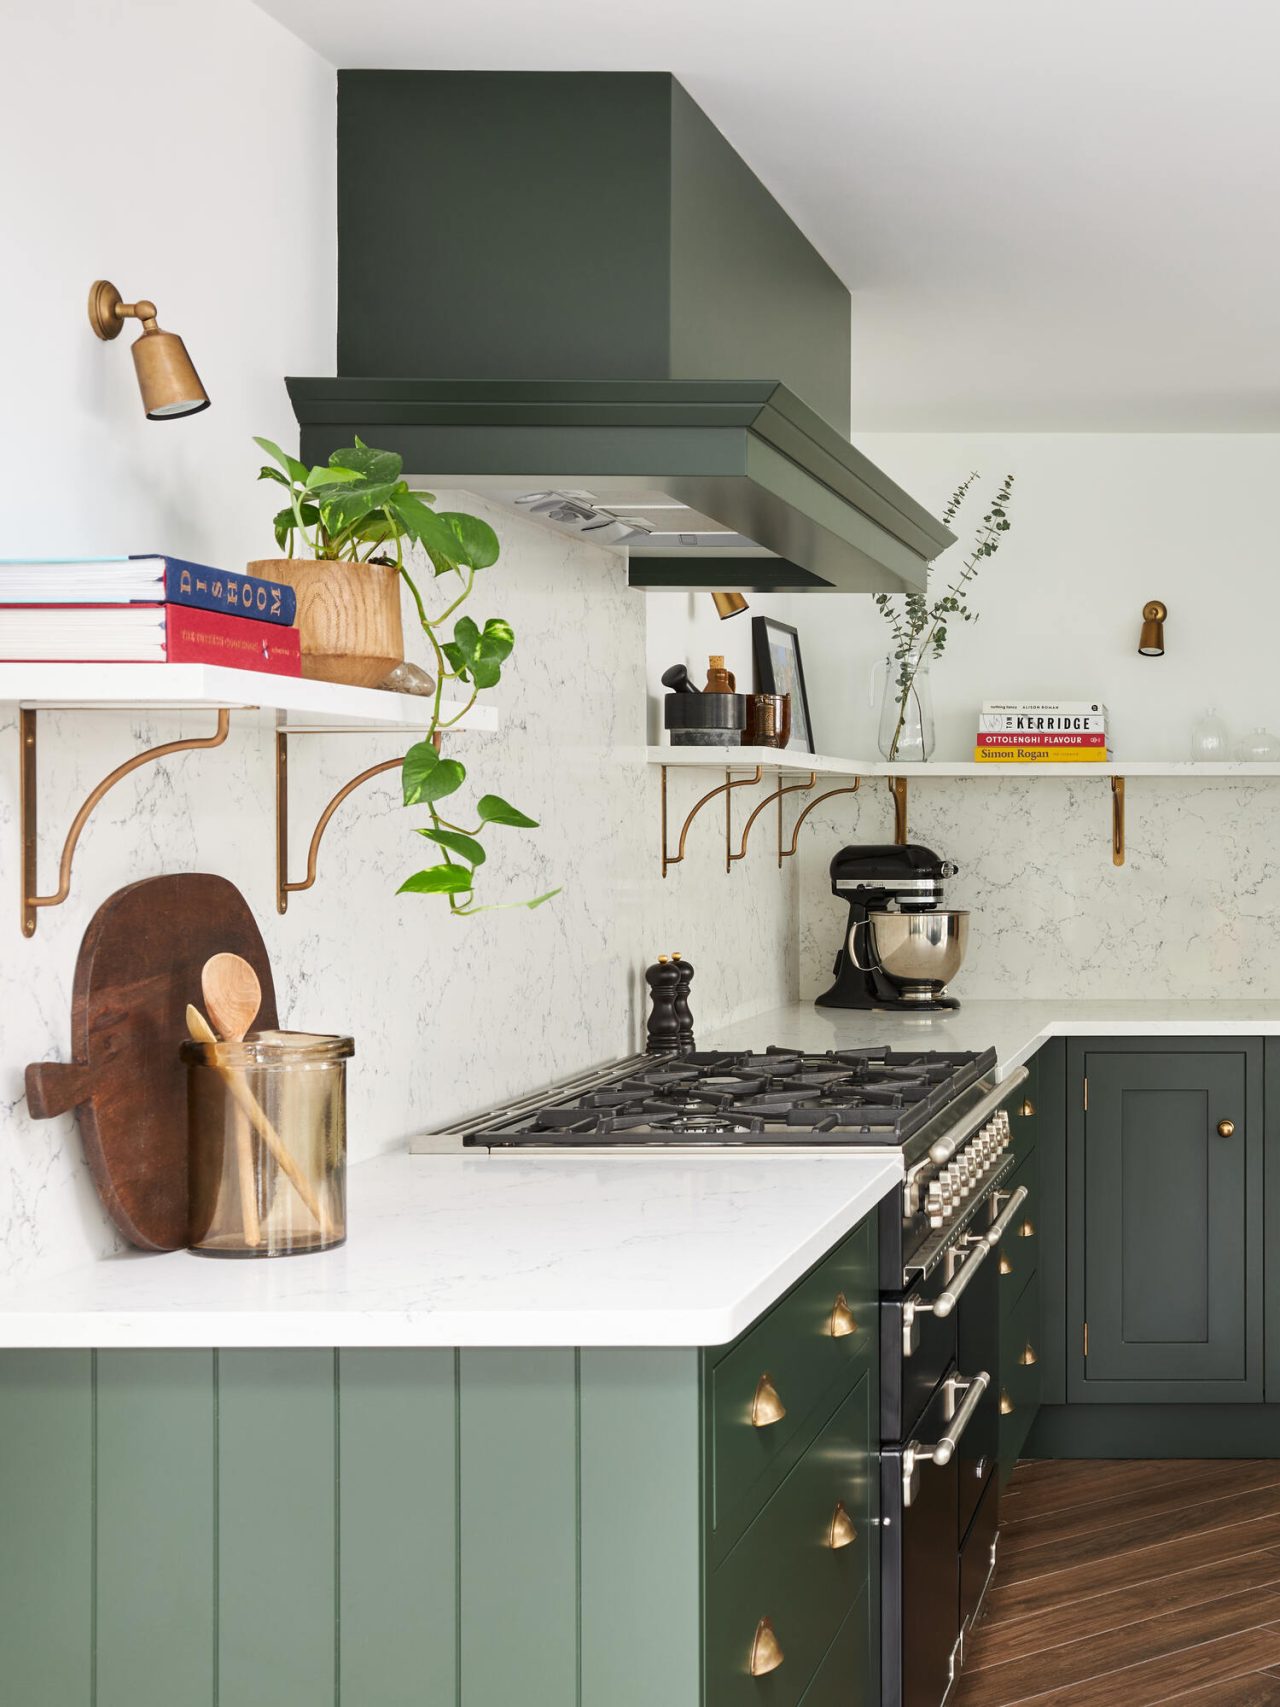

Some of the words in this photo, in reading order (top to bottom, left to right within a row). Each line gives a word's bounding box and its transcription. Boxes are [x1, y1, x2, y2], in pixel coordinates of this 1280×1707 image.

[180, 569, 280, 616] DISHOOM
[1017, 716, 1090, 730] KERRIDGE
[985, 736, 1041, 744] OTTOLENGHI
[1044, 736, 1082, 744] FLAVOUR
[981, 749, 1014, 758] Simon
[1017, 749, 1049, 761] Rogan
